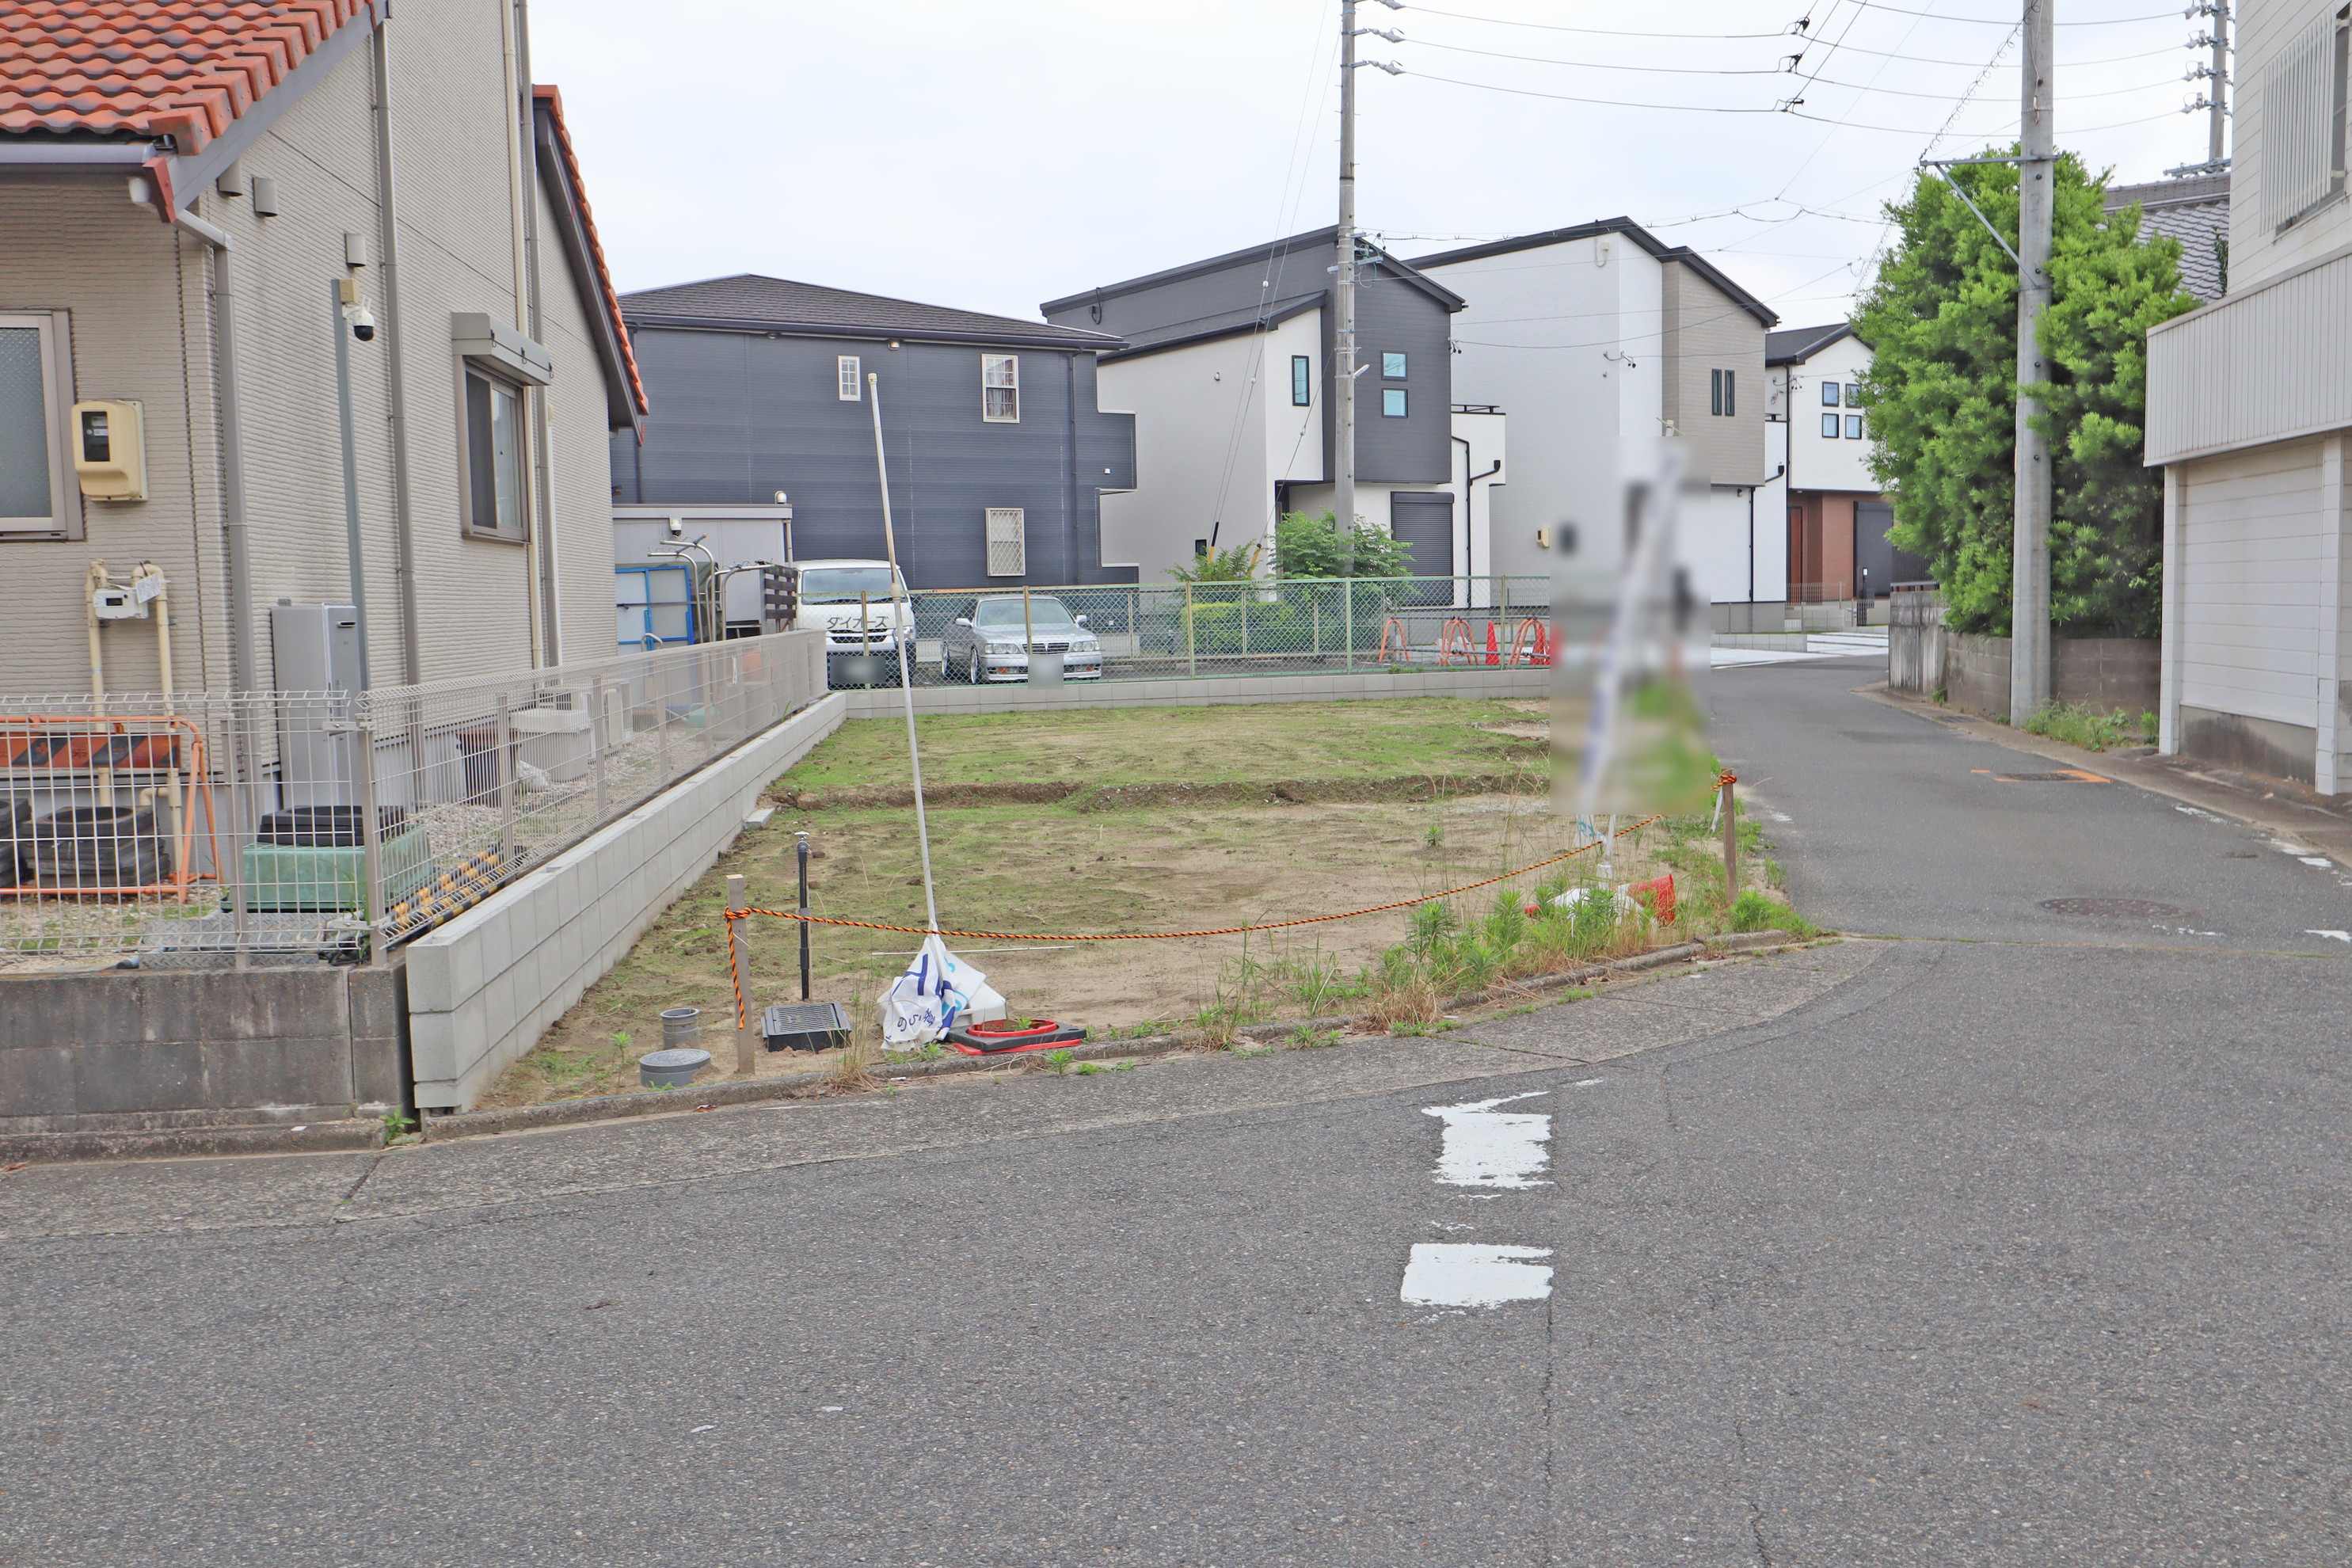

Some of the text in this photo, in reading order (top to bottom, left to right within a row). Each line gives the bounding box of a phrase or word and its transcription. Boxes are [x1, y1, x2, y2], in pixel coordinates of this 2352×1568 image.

[827, 616, 889, 630] ダイオーズ
